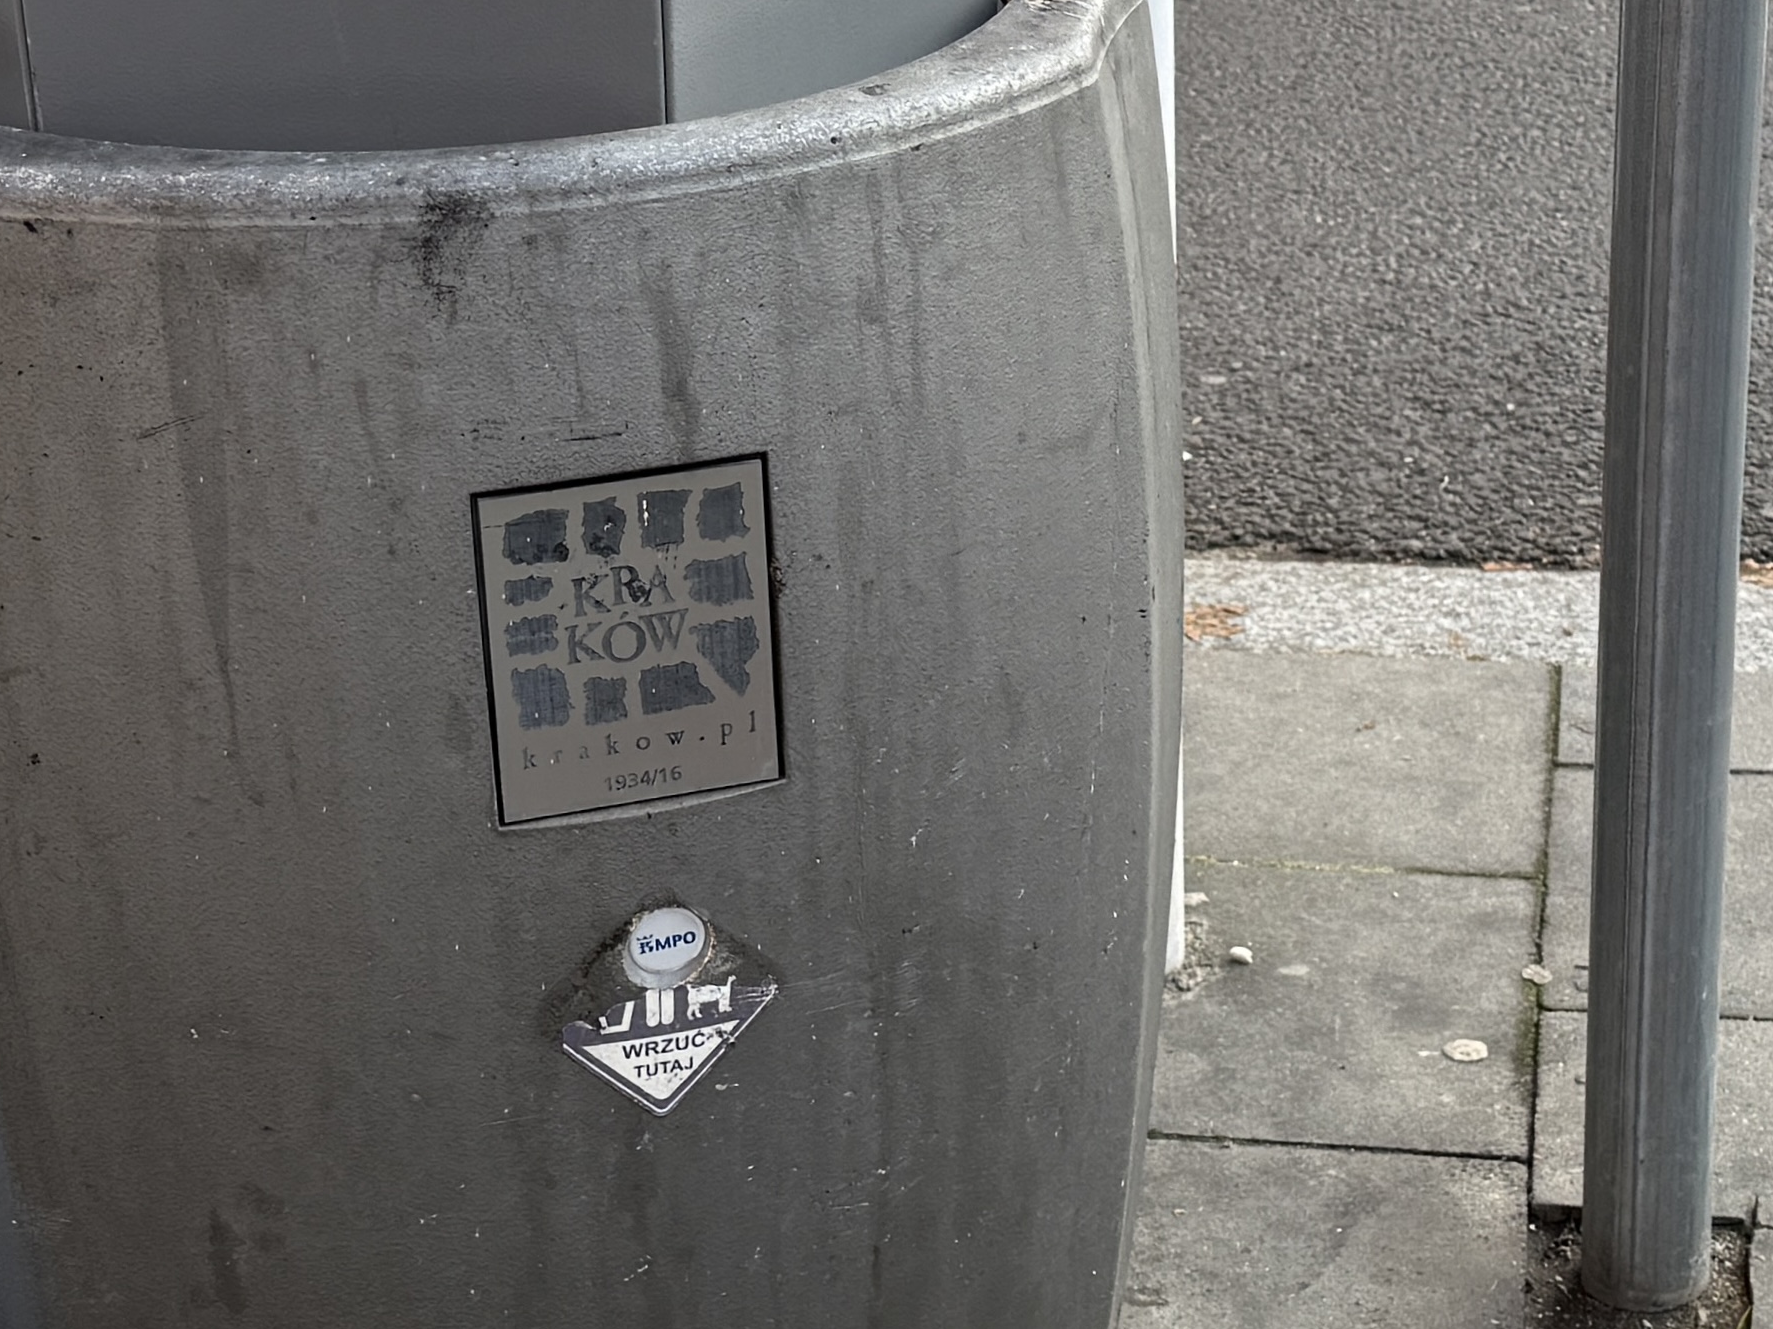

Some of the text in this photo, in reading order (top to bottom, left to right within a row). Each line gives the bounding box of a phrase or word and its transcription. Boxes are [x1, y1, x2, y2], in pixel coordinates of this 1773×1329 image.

[572, 565, 676, 618] KRA
[565, 608, 689, 665] KÓW
[605, 765, 683, 793] 1934/16
[622, 1029, 707, 1060] WRZUĆ
[634, 1056, 695, 1079] TUTAJ
